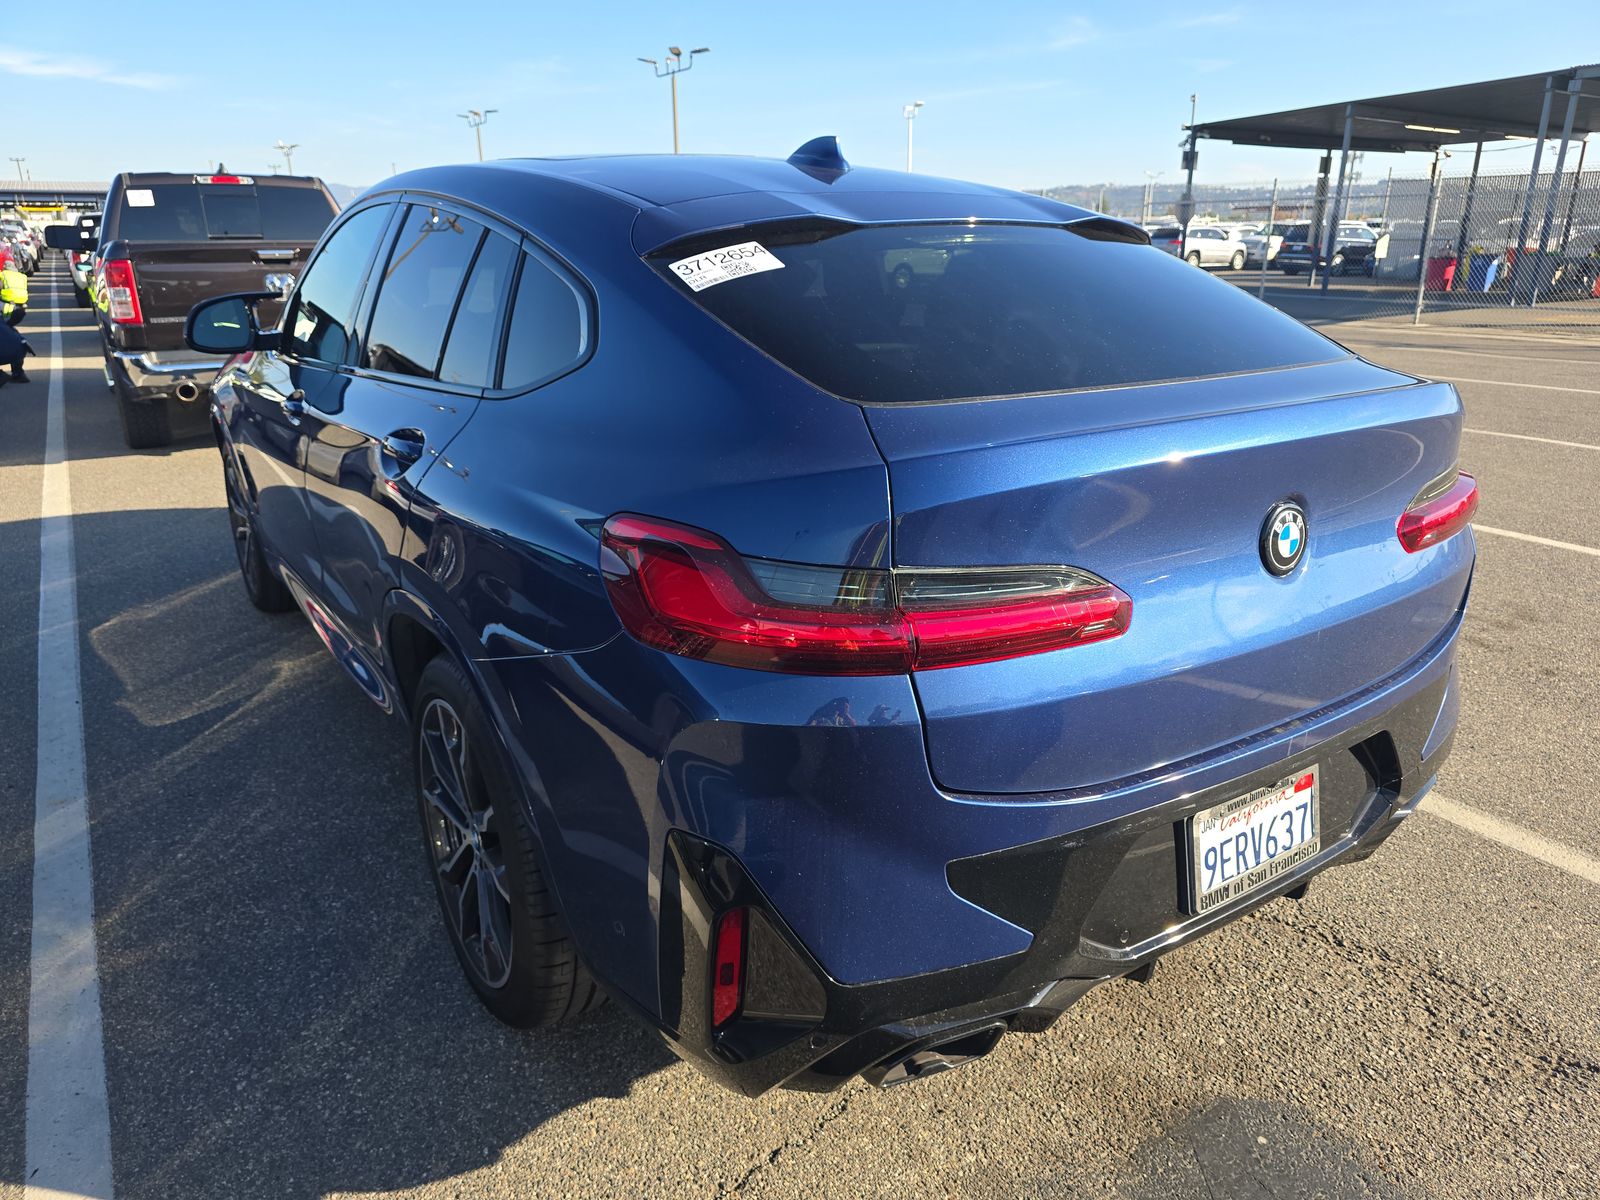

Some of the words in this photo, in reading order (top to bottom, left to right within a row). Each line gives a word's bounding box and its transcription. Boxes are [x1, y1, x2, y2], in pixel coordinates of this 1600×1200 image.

[677, 245, 766, 276] 3712654
[1273, 512, 1303, 533] BMW
[1201, 818, 1216, 834] JAN
[1220, 790, 1294, 831] California
[1204, 802, 1309, 890] 9ERV637
[1200, 885, 1230, 911] BMW
[1233, 879, 1244, 895] of
[1247, 870, 1267, 887] San
[1270, 841, 1318, 877] Francisco
